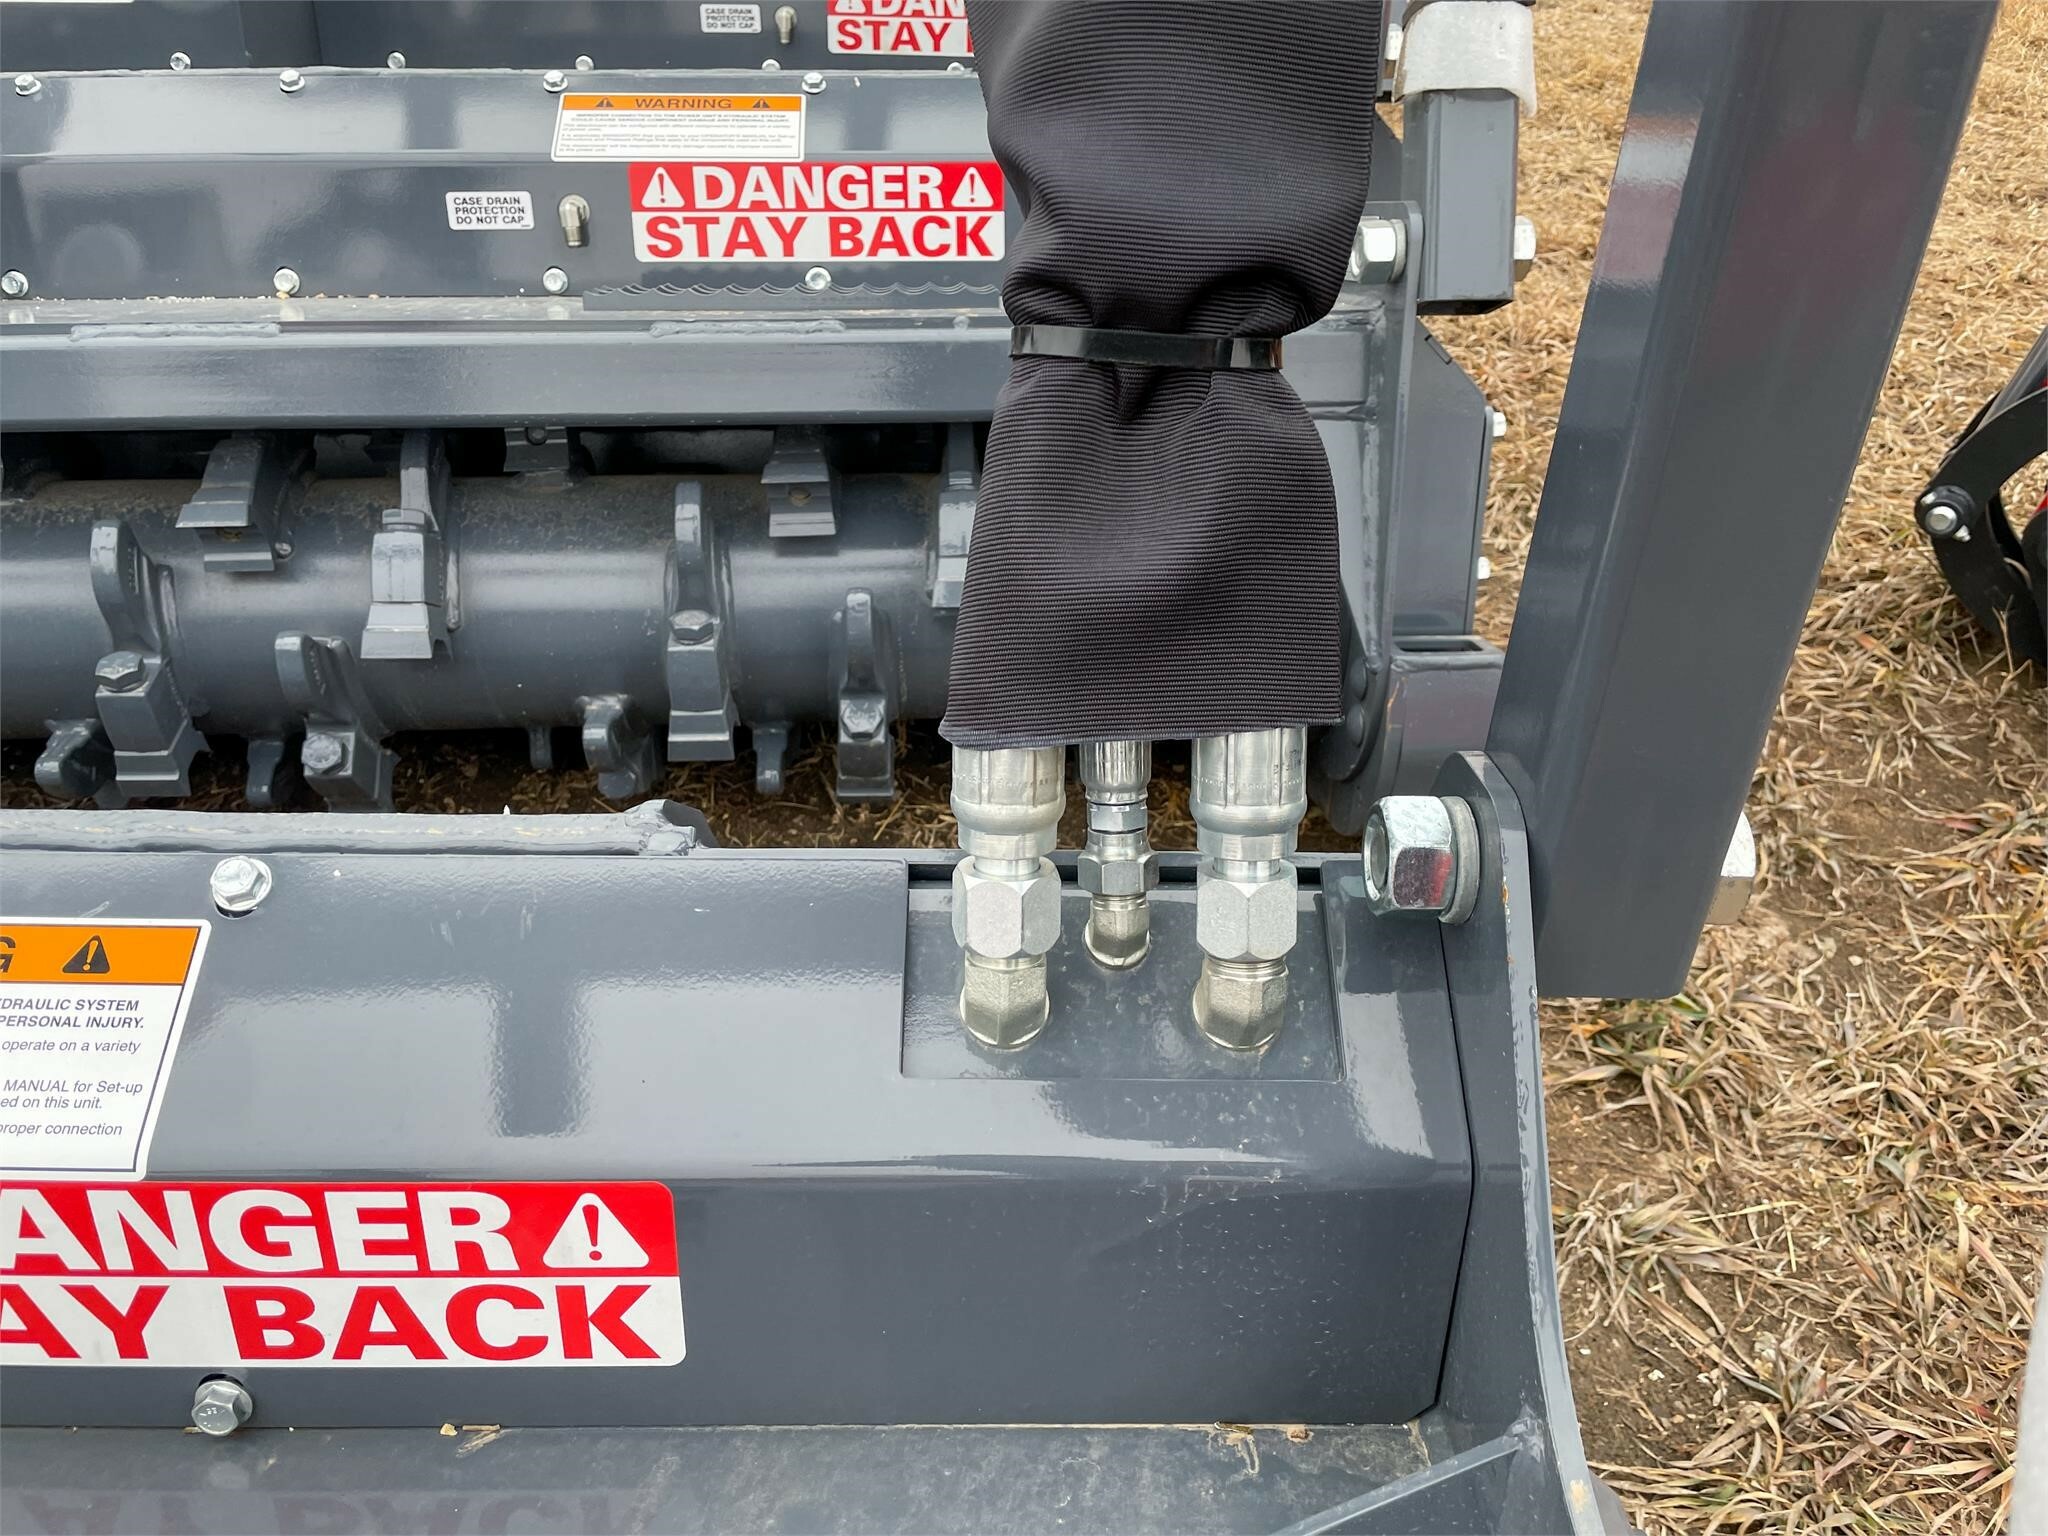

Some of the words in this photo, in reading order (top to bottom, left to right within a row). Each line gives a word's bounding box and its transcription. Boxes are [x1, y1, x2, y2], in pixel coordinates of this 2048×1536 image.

[837, 19, 951, 52] STAY
[635, 98, 732, 109] WARNING
[691, 164, 944, 210] DANGER
[453, 197, 482, 206] CASE
[487, 196, 520, 205] DRAIN
[455, 206, 525, 215] PROTECTION
[457, 216, 472, 225] DO
[476, 216, 497, 224] NOT
[503, 216, 524, 224] CAP
[645, 216, 808, 258] STAY
[829, 215, 993, 257] BACK
[0, 998, 71, 1011] DRAULIC
[74, 999, 139, 1011] SYSTEM
[0, 1015, 81, 1028] PERSONAL
[85, 1016, 144, 1029] INJURY.
[2, 1040, 55, 1054] operate
[59, 1041, 77, 1051] on
[81, 1042, 90, 1052] a
[94, 1040, 141, 1055] variety
[3, 1079, 69, 1093] MANUAL
[73, 1080, 92, 1093] for
[96, 1080, 143, 1095] Set-up
[22, 1098, 40, 1109] on
[44, 1096, 69, 1109] this
[73, 1097, 103, 1110] unit.
[45, 1122, 123, 1136] connection
[0, 1188, 520, 1272] ANGER
[222, 1283, 663, 1361] BACK
